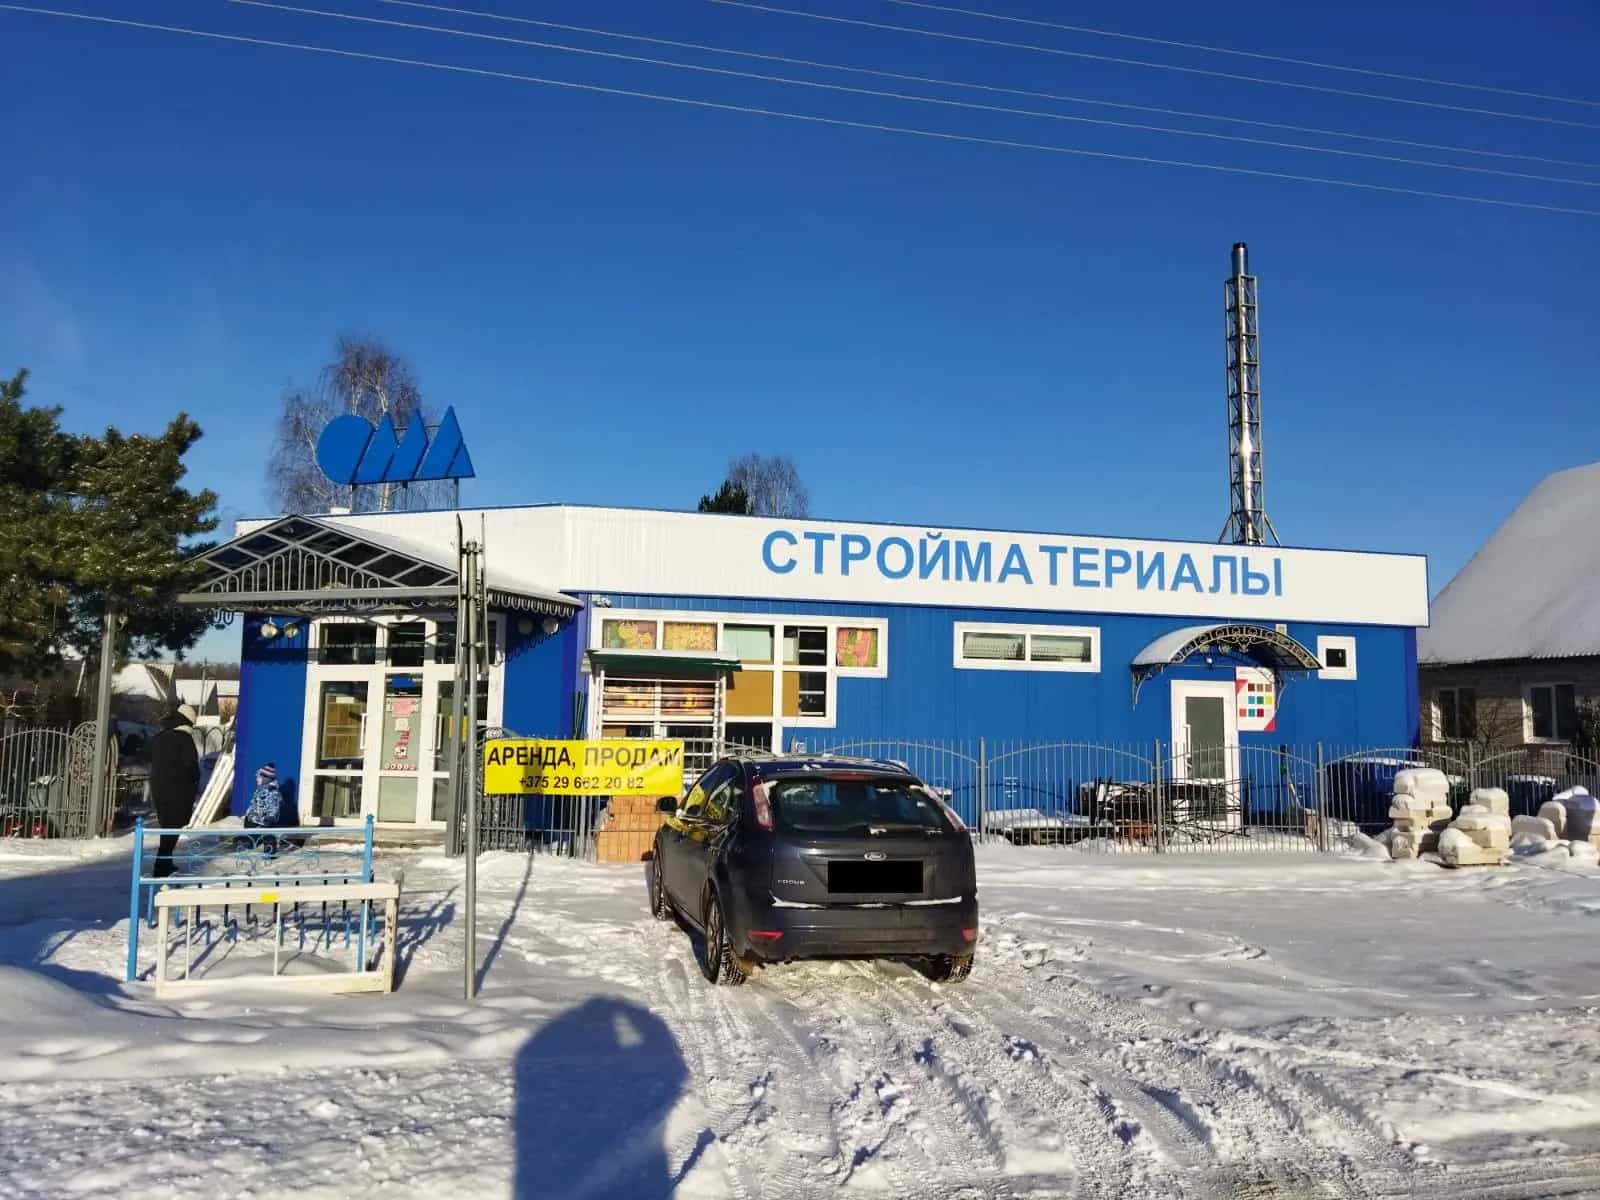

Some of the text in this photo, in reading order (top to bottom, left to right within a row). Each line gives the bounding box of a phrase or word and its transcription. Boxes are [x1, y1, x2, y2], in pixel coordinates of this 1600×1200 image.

[762, 530, 1282, 596] СТРОЙМАТЕРИАЛЫ
[487, 746, 680, 770] АРЕНДА, ПРОДАМ
[520, 775, 644, 789] +375 29 662 20 82
